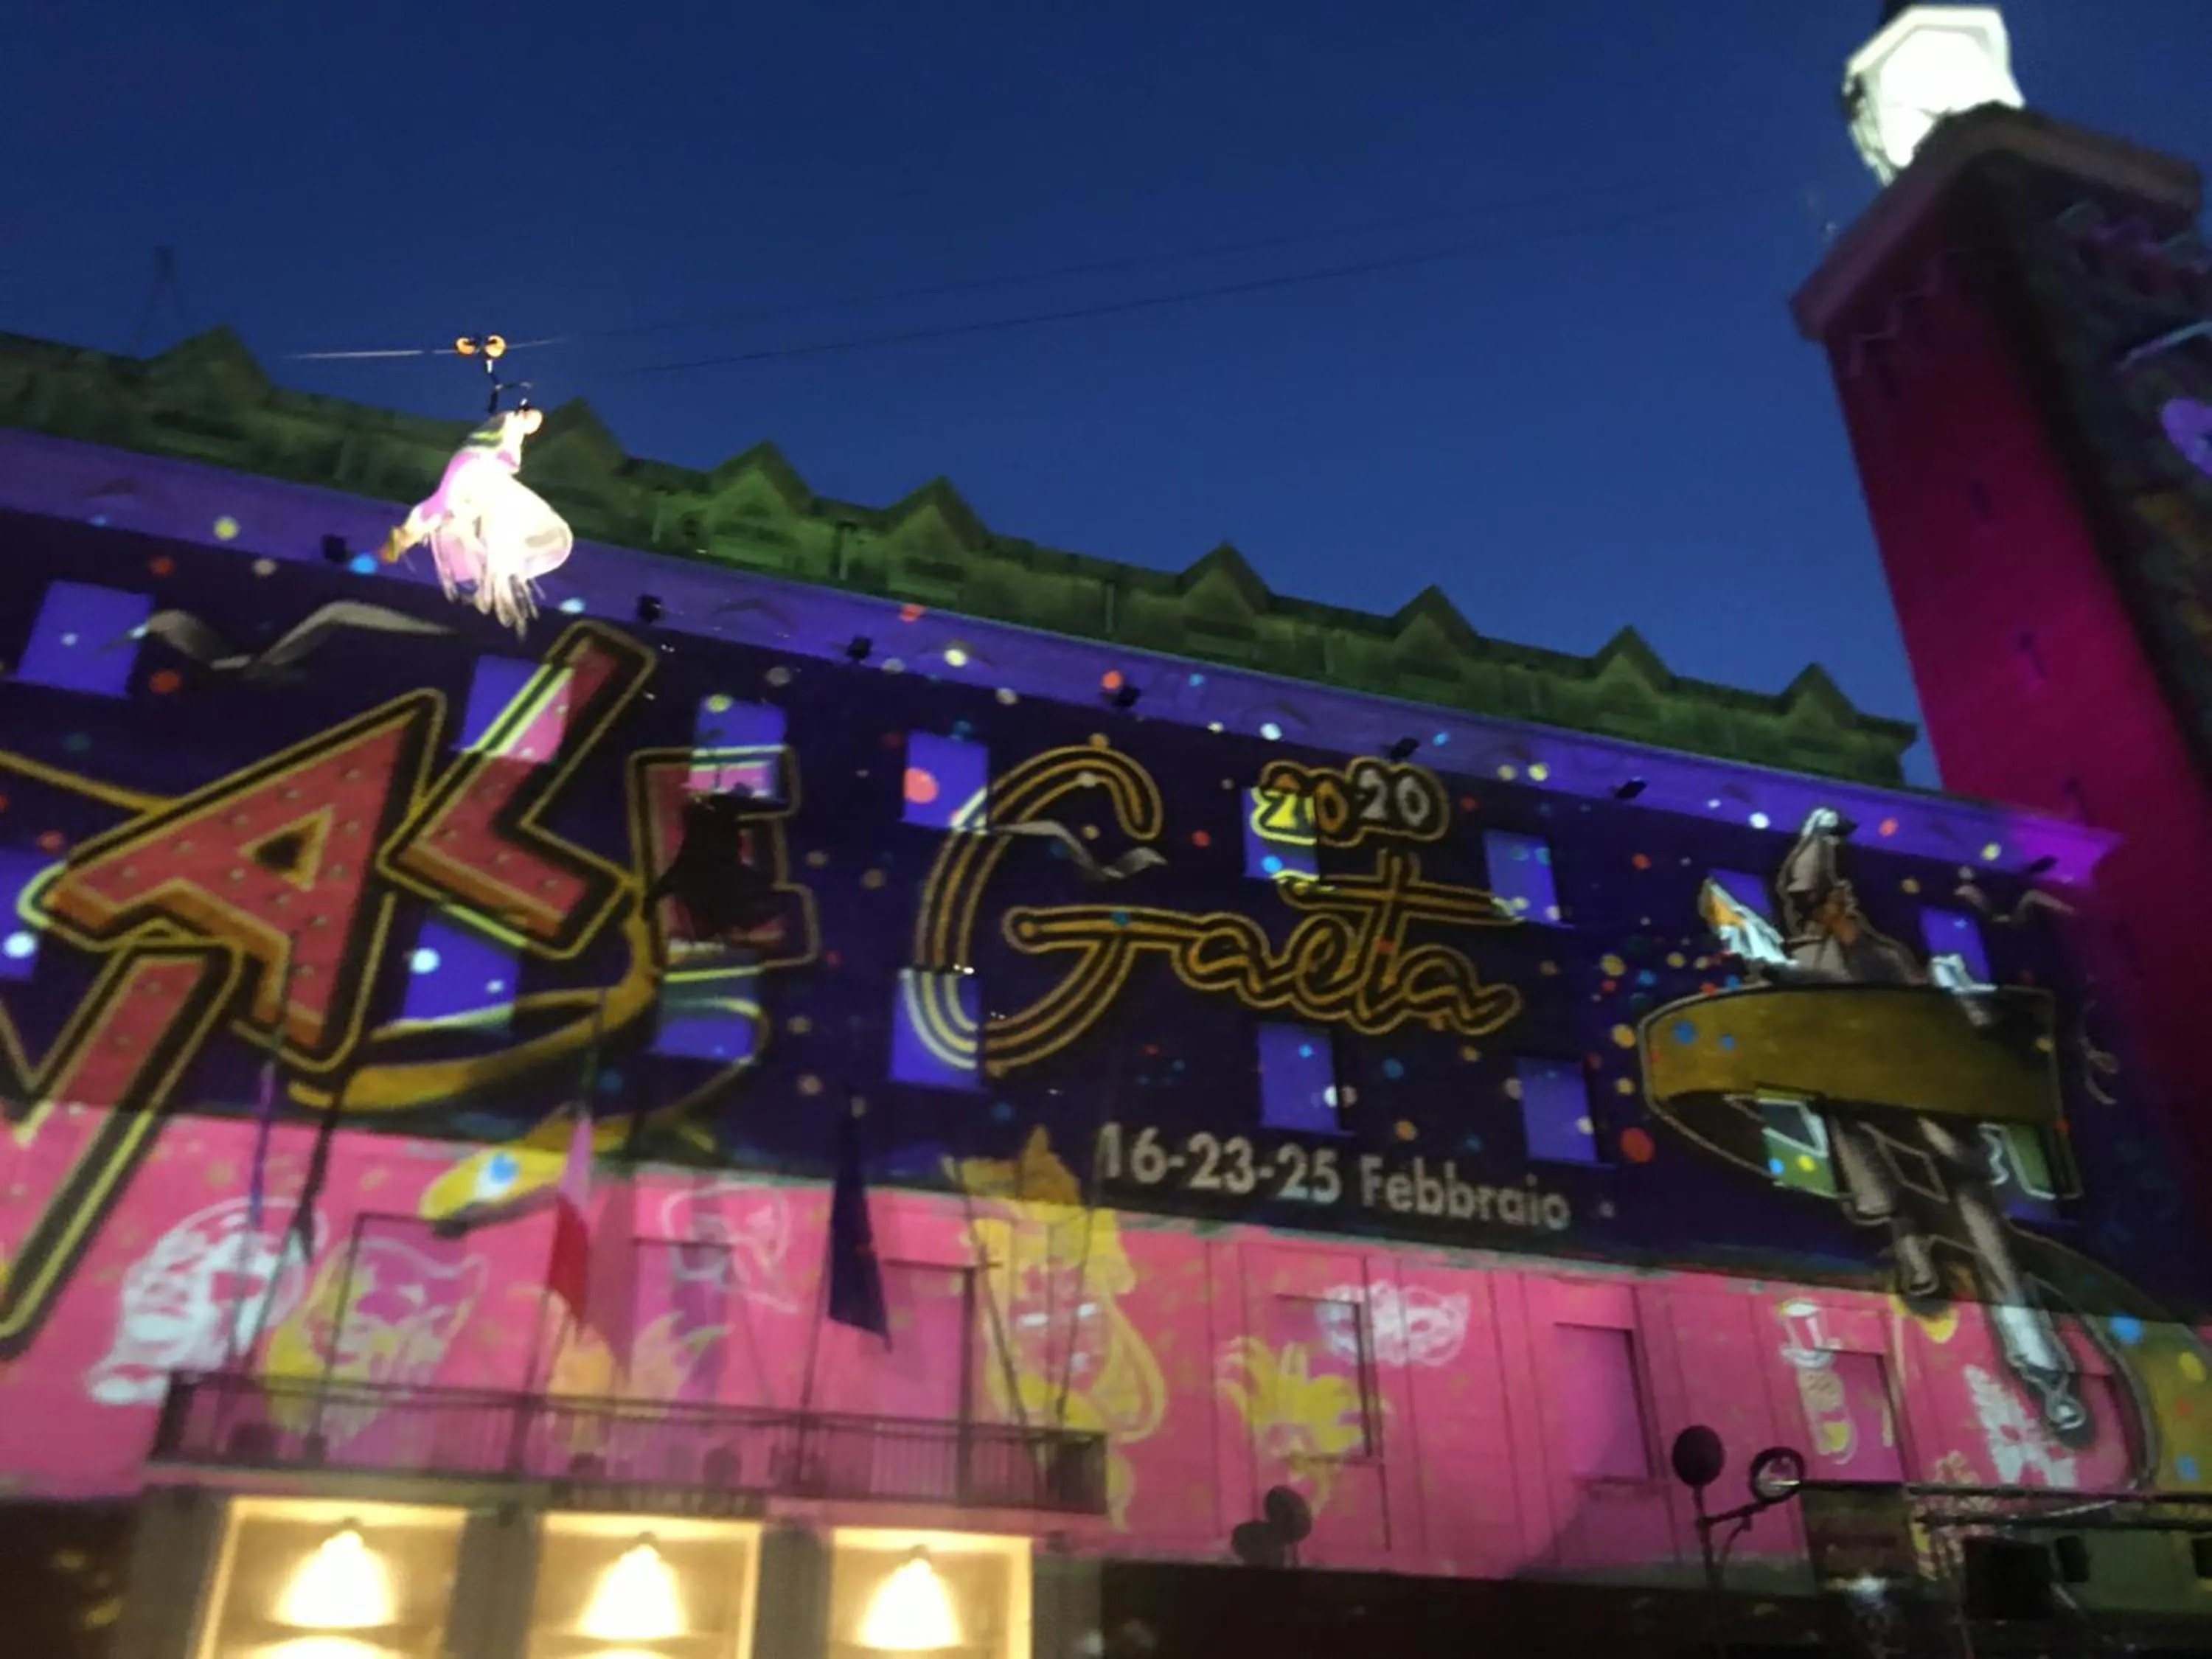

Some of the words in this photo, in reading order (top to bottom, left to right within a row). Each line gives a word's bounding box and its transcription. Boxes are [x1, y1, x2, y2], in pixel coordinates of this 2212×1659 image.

[1255, 759, 1443, 844] 2020
[902, 745, 1522, 1078] Gaeta
[1099, 1121, 1343, 1203] 16-23-25
[1360, 1154, 1571, 1230] Febbraio
